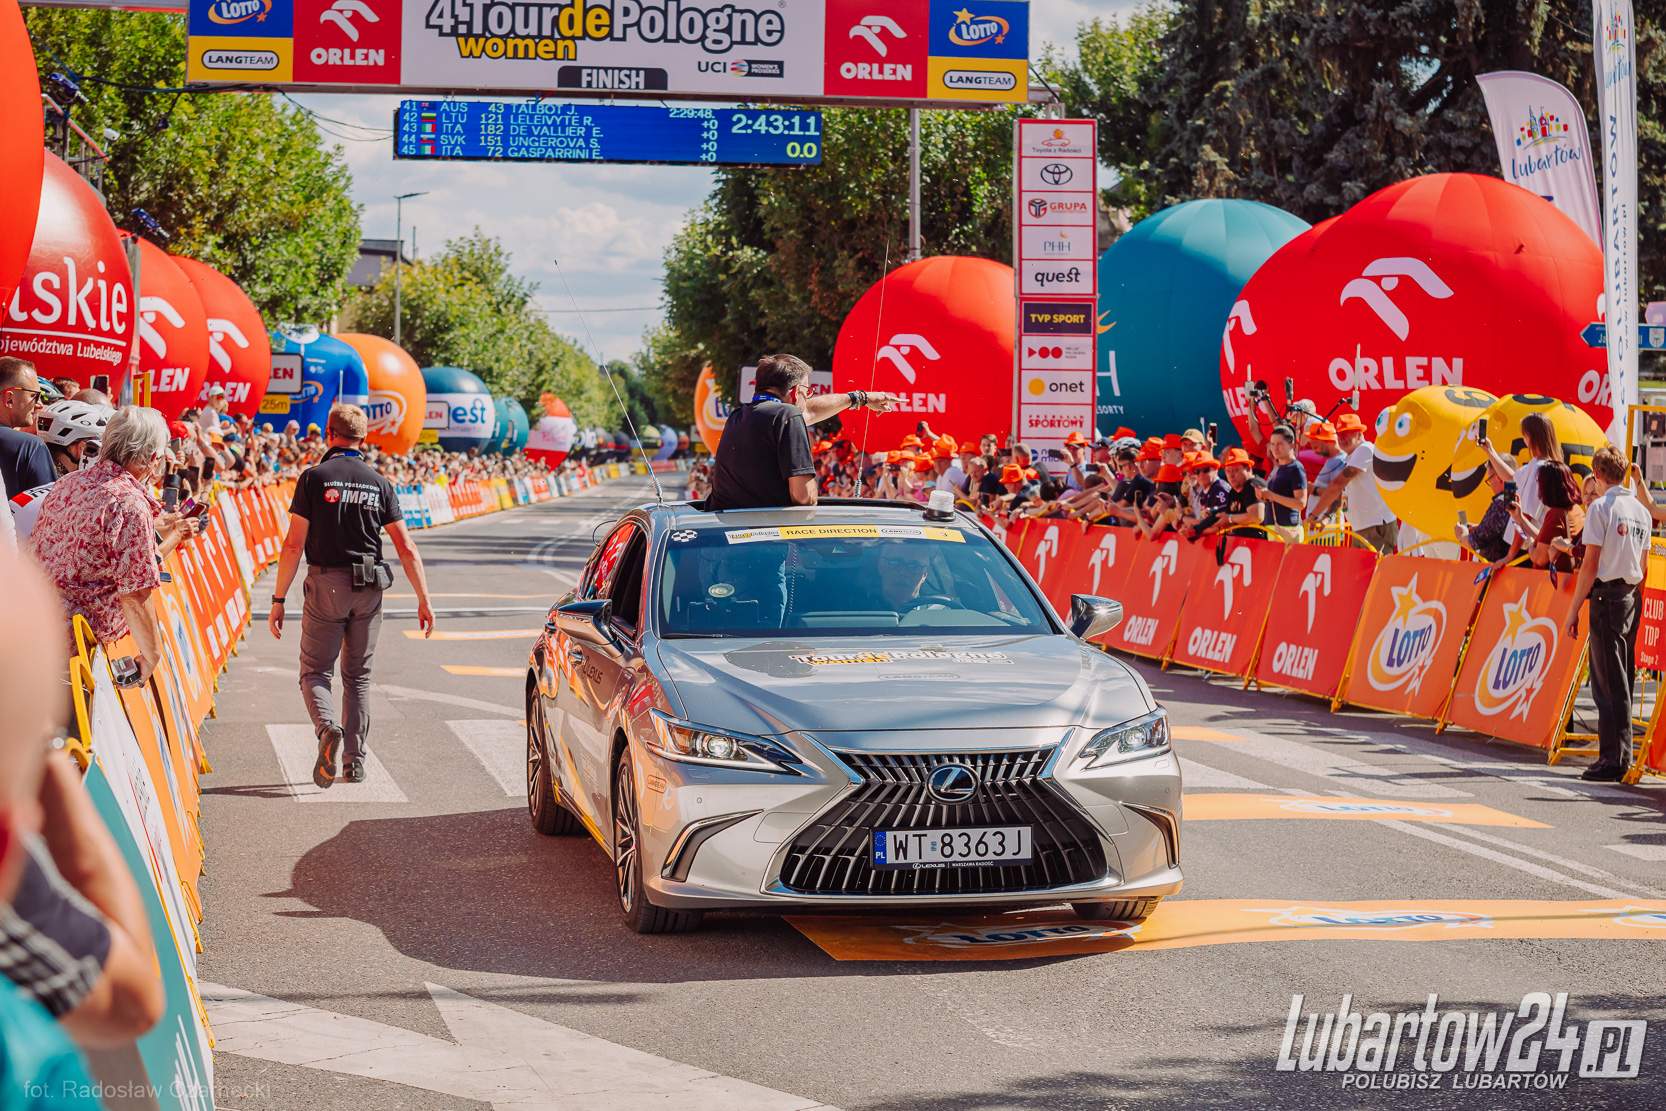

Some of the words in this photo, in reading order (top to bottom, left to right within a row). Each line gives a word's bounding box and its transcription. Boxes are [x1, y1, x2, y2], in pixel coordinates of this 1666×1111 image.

[221, 0, 260, 18] LOTTO
[961, 22, 998, 40] LOTTO
[456, 37, 577, 60] women
[208, 56, 274, 65] LANGTEAM
[310, 48, 384, 66] ORLEN
[698, 61, 727, 74] UCI
[840, 62, 912, 80] ORLEN
[581, 68, 646, 90] FINISH
[950, 76, 1011, 86] LANGTEAM
[440, 102, 468, 112] AUS
[512, 104, 564, 114] TALBOT
[404, 114, 418, 122] 42
[442, 113, 466, 122] LTU
[480, 114, 504, 124] 121
[510, 115, 580, 125] LELEIVYTE
[702, 120, 718, 130] +0
[731, 114, 820, 135] 2:43:11
[403, 124, 417, 132] 43
[442, 125, 464, 134] ITA
[480, 125, 504, 134] 182
[510, 126, 528, 135] DE
[532, 127, 586, 137] VALLIER
[701, 130, 718, 141] +0
[402, 135, 416, 143] 44
[440, 135, 466, 145] SVK
[480, 136, 503, 146] 151
[510, 136, 586, 148] UNGEROVA
[701, 141, 718, 152] +0
[402, 146, 416, 154] 45
[442, 146, 463, 156] ITA
[488, 147, 504, 157] 72
[508, 148, 589, 159] GASPARRINI
[700, 152, 716, 162] +0
[786, 142, 817, 158] 0.0
[1050, 202, 1088, 210] GRUPA
[1044, 241, 1070, 252] PHH
[1034, 267, 1080, 286] quest
[1030, 314, 1051, 323] TVP
[1052, 314, 1086, 324] SPORT
[1328, 357, 1464, 392] ORLEN
[1049, 380, 1085, 392] onet
[1028, 419, 1084, 428] SPORTOWY
[342, 490, 380, 506] IMPEL
[1644, 598, 1664, 621] CLUB
[1123, 615, 1159, 646] ORLEN
[1644, 624, 1660, 648] TDP
[1188, 626, 1237, 664] ORLEN
[1386, 624, 1432, 668] LOTTO
[1272, 642, 1319, 680] ORLEN
[1492, 642, 1542, 690] LOTTO
[894, 834, 928, 861] WT
[940, 830, 1021, 859] 8363J
[952, 925, 1090, 943] LOTTO
